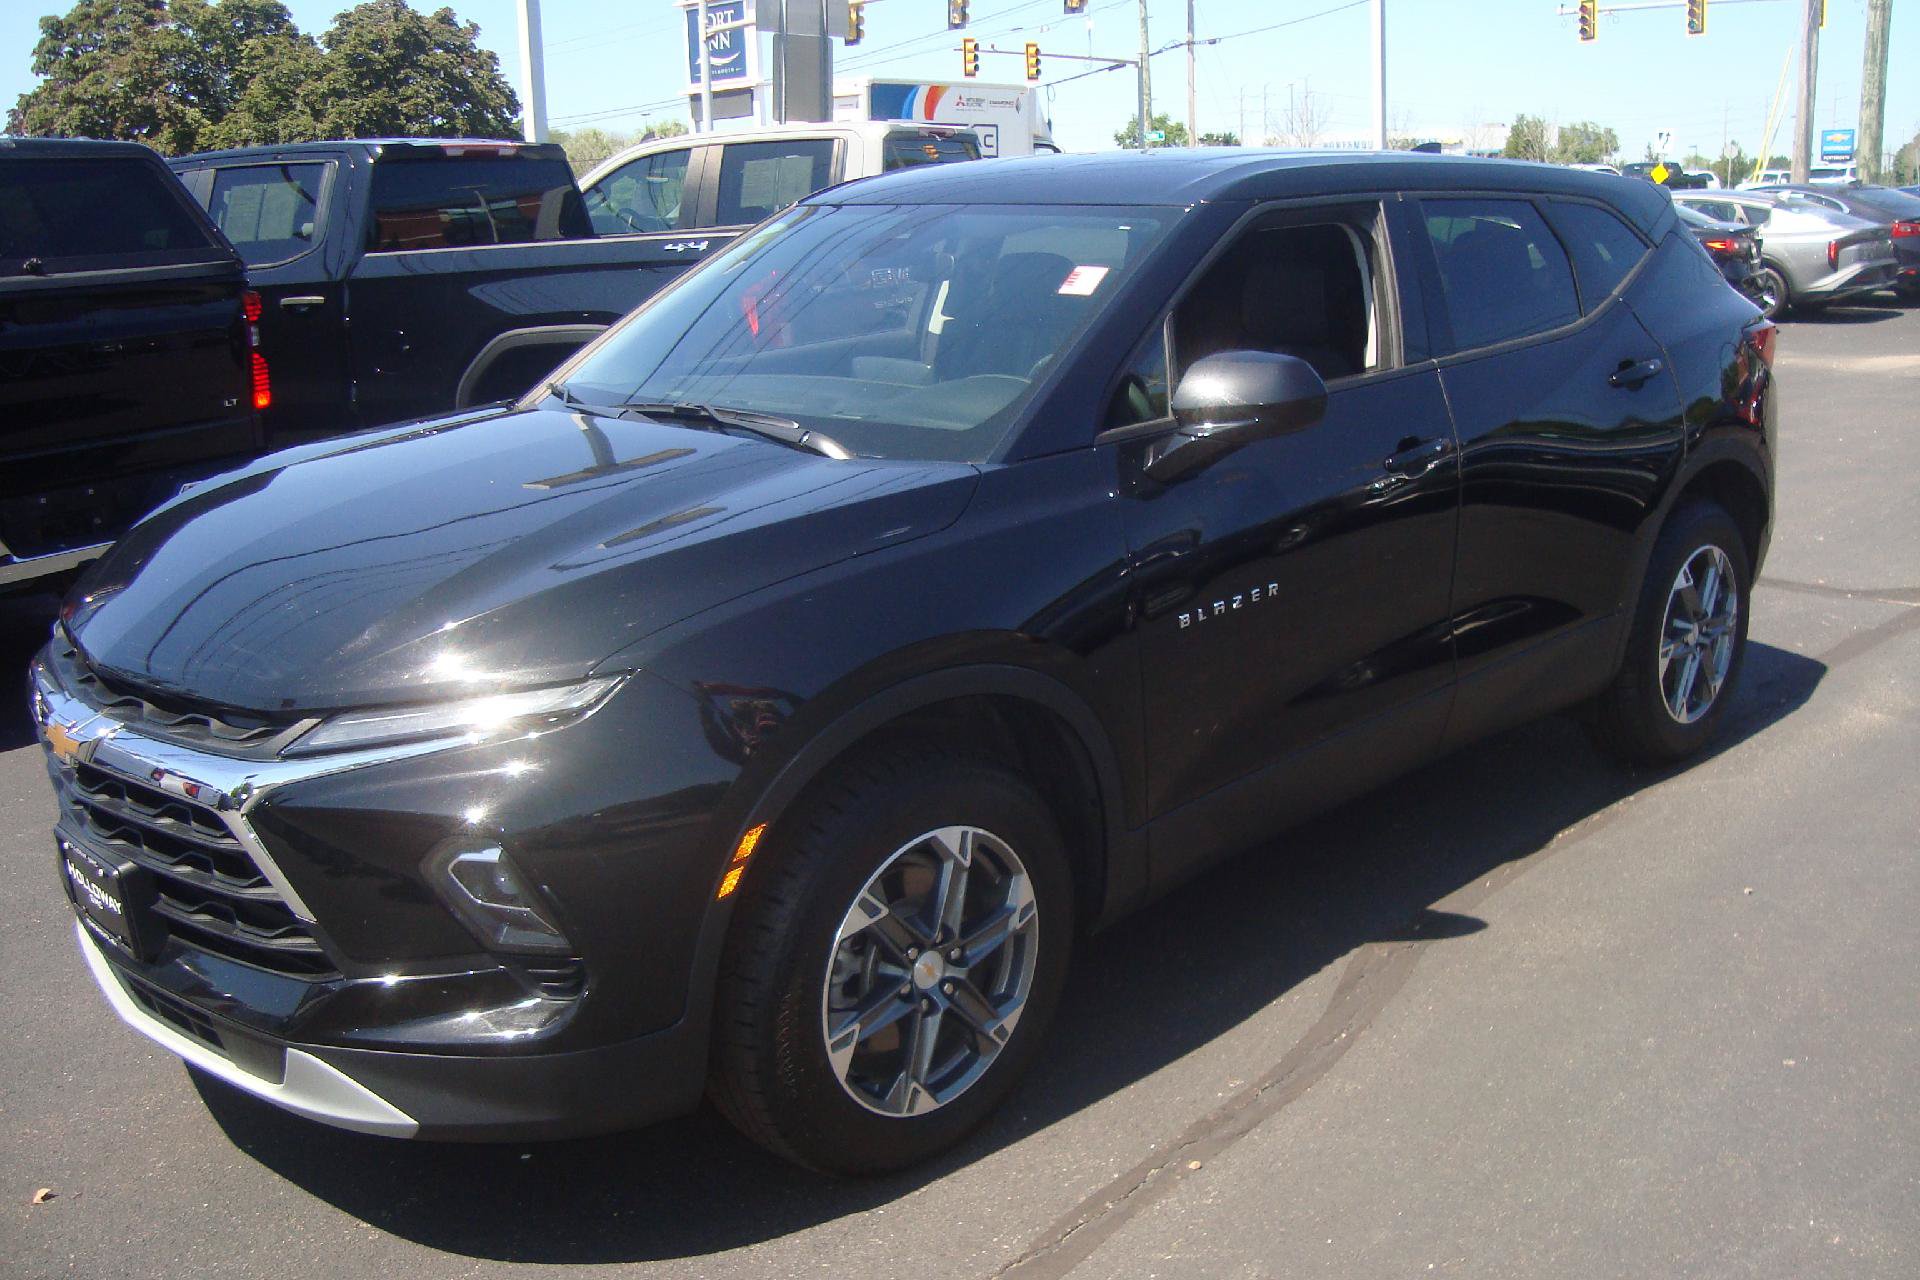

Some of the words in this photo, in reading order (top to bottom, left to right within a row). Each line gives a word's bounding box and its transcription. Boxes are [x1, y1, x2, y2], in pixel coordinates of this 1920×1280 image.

[225, 398, 238, 407] LT
[1178, 582, 1280, 629] BLAZER
[66, 858, 122, 915] HOLLOWAY
